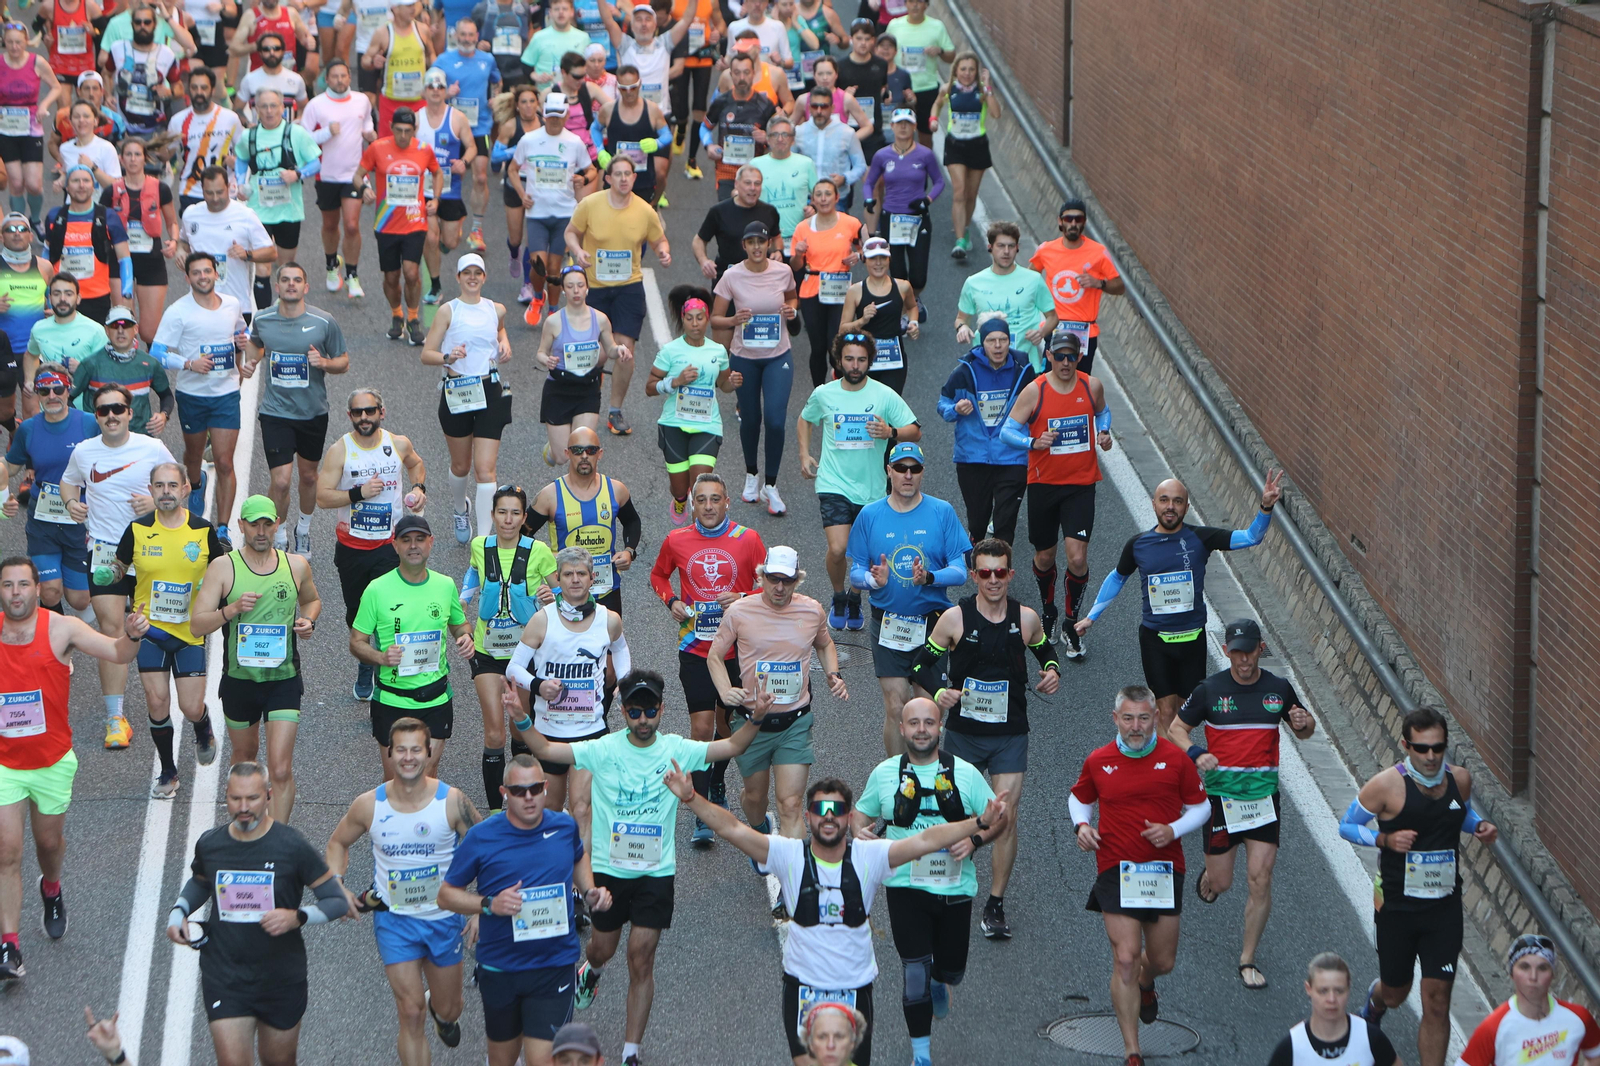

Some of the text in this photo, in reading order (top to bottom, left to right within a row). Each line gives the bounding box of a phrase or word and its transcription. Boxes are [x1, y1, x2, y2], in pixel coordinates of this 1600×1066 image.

[281, 366, 297, 374] 12273
[456, 377, 478, 386] ZURICH
[690, 389, 711, 397] ZURICH
[1062, 417, 1084, 426] ZURICH
[845, 433, 863, 441] ÁLVARO
[365, 504, 389, 512] ZURICH
[362, 516, 381, 525] 11450
[1162, 574, 1187, 584] ZURICH
[1162, 588, 1181, 596] 10565
[164, 598, 183, 607] 11075
[155, 605, 174, 613] ETIOPE
[254, 627, 281, 635] ZURICH
[896, 625, 911, 633] 9782
[413, 633, 437, 641] ZURICH
[892, 634, 912, 643] THOMAS
[254, 641, 270, 649] 5627
[253, 650, 270, 658] TRINO
[545, 663, 595, 679] PUMA
[564, 682, 590, 690] ZURICH
[978, 683, 1003, 691] ZURICH
[7, 694, 36, 704] ZURICH
[976, 697, 993, 705] 9778
[9, 709, 26, 718] 7554
[5, 719, 33, 730] ANTHONY
[630, 825, 657, 835] ZURICH
[628, 842, 645, 850] 9690
[627, 851, 645, 860] TALAL
[1424, 855, 1451, 863] ZURICH
[929, 859, 947, 867] 9045
[929, 868, 947, 876] DANIÉ
[1138, 864, 1168, 872] ZURICH
[404, 867, 434, 880] ZURICH
[236, 875, 266, 885] ZURICH
[1137, 880, 1158, 888] 11043
[1423, 880, 1442, 888] CLARA
[404, 885, 427, 895] 10313
[529, 889, 558, 900] ZURICH
[532, 907, 550, 916] 9725
[531, 918, 554, 928] JOSELU
[818, 993, 848, 1002] ZURICH
[1521, 1030, 1559, 1050] DEXTRO
